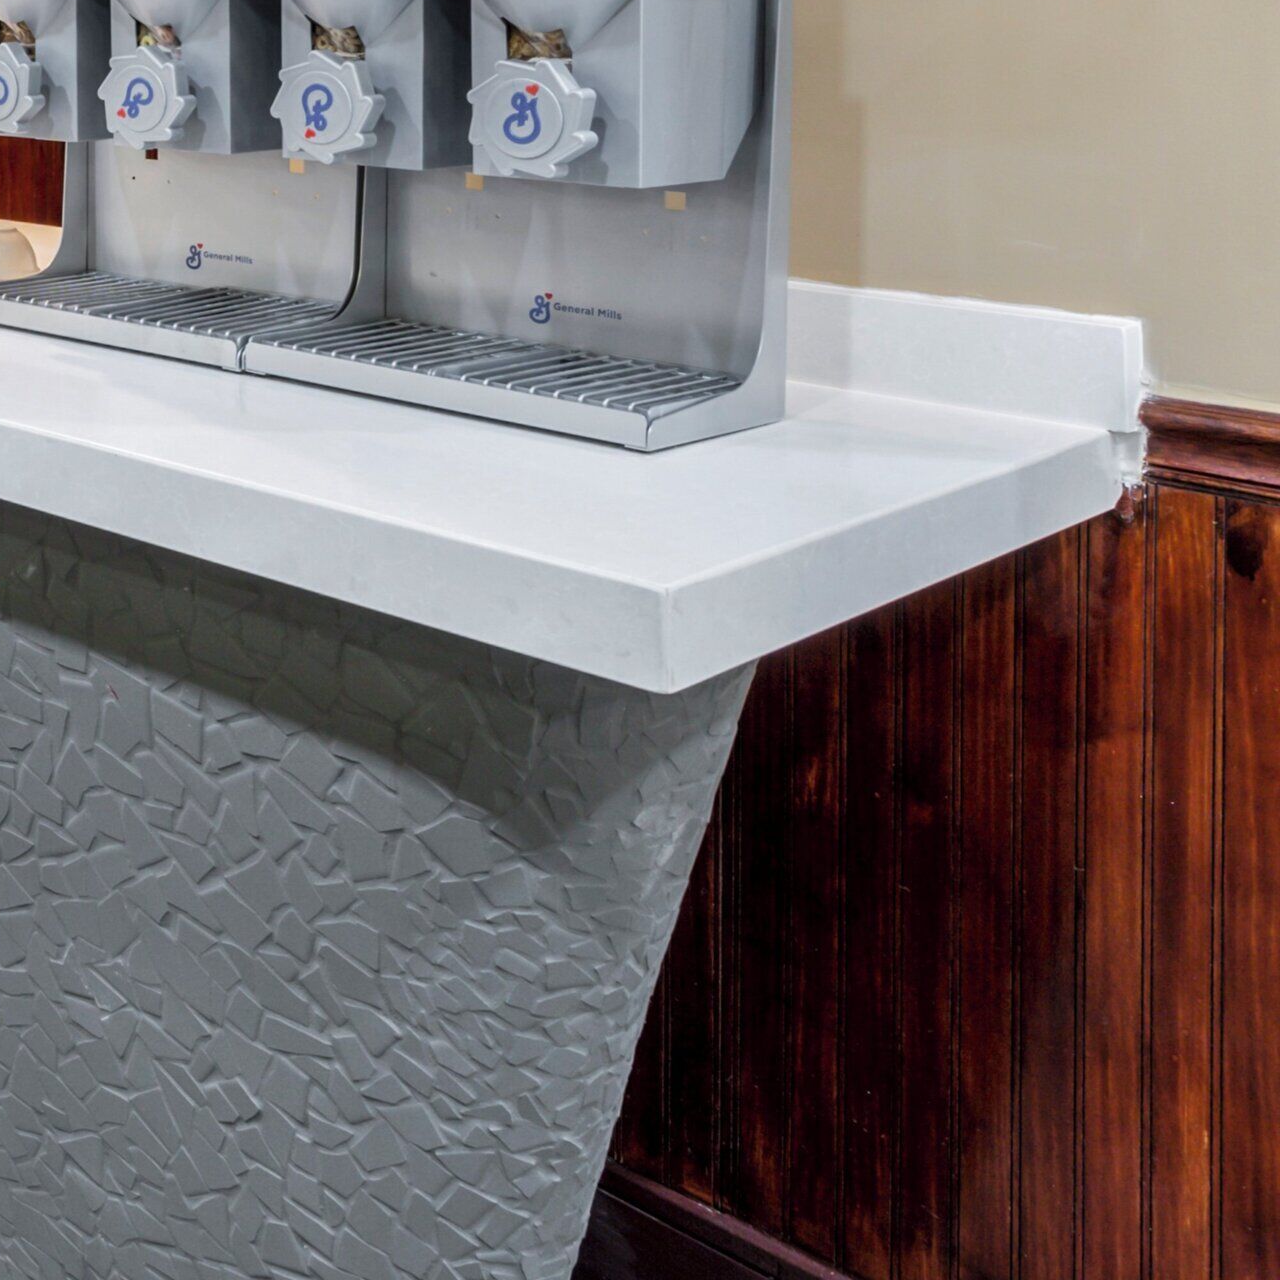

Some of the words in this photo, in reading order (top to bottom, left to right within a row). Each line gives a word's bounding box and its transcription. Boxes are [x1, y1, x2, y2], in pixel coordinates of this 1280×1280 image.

[203, 251, 232, 261] General
[235, 255, 252, 264] Mills
[554, 303, 594, 316] General
[598, 309, 622, 320] Mills
